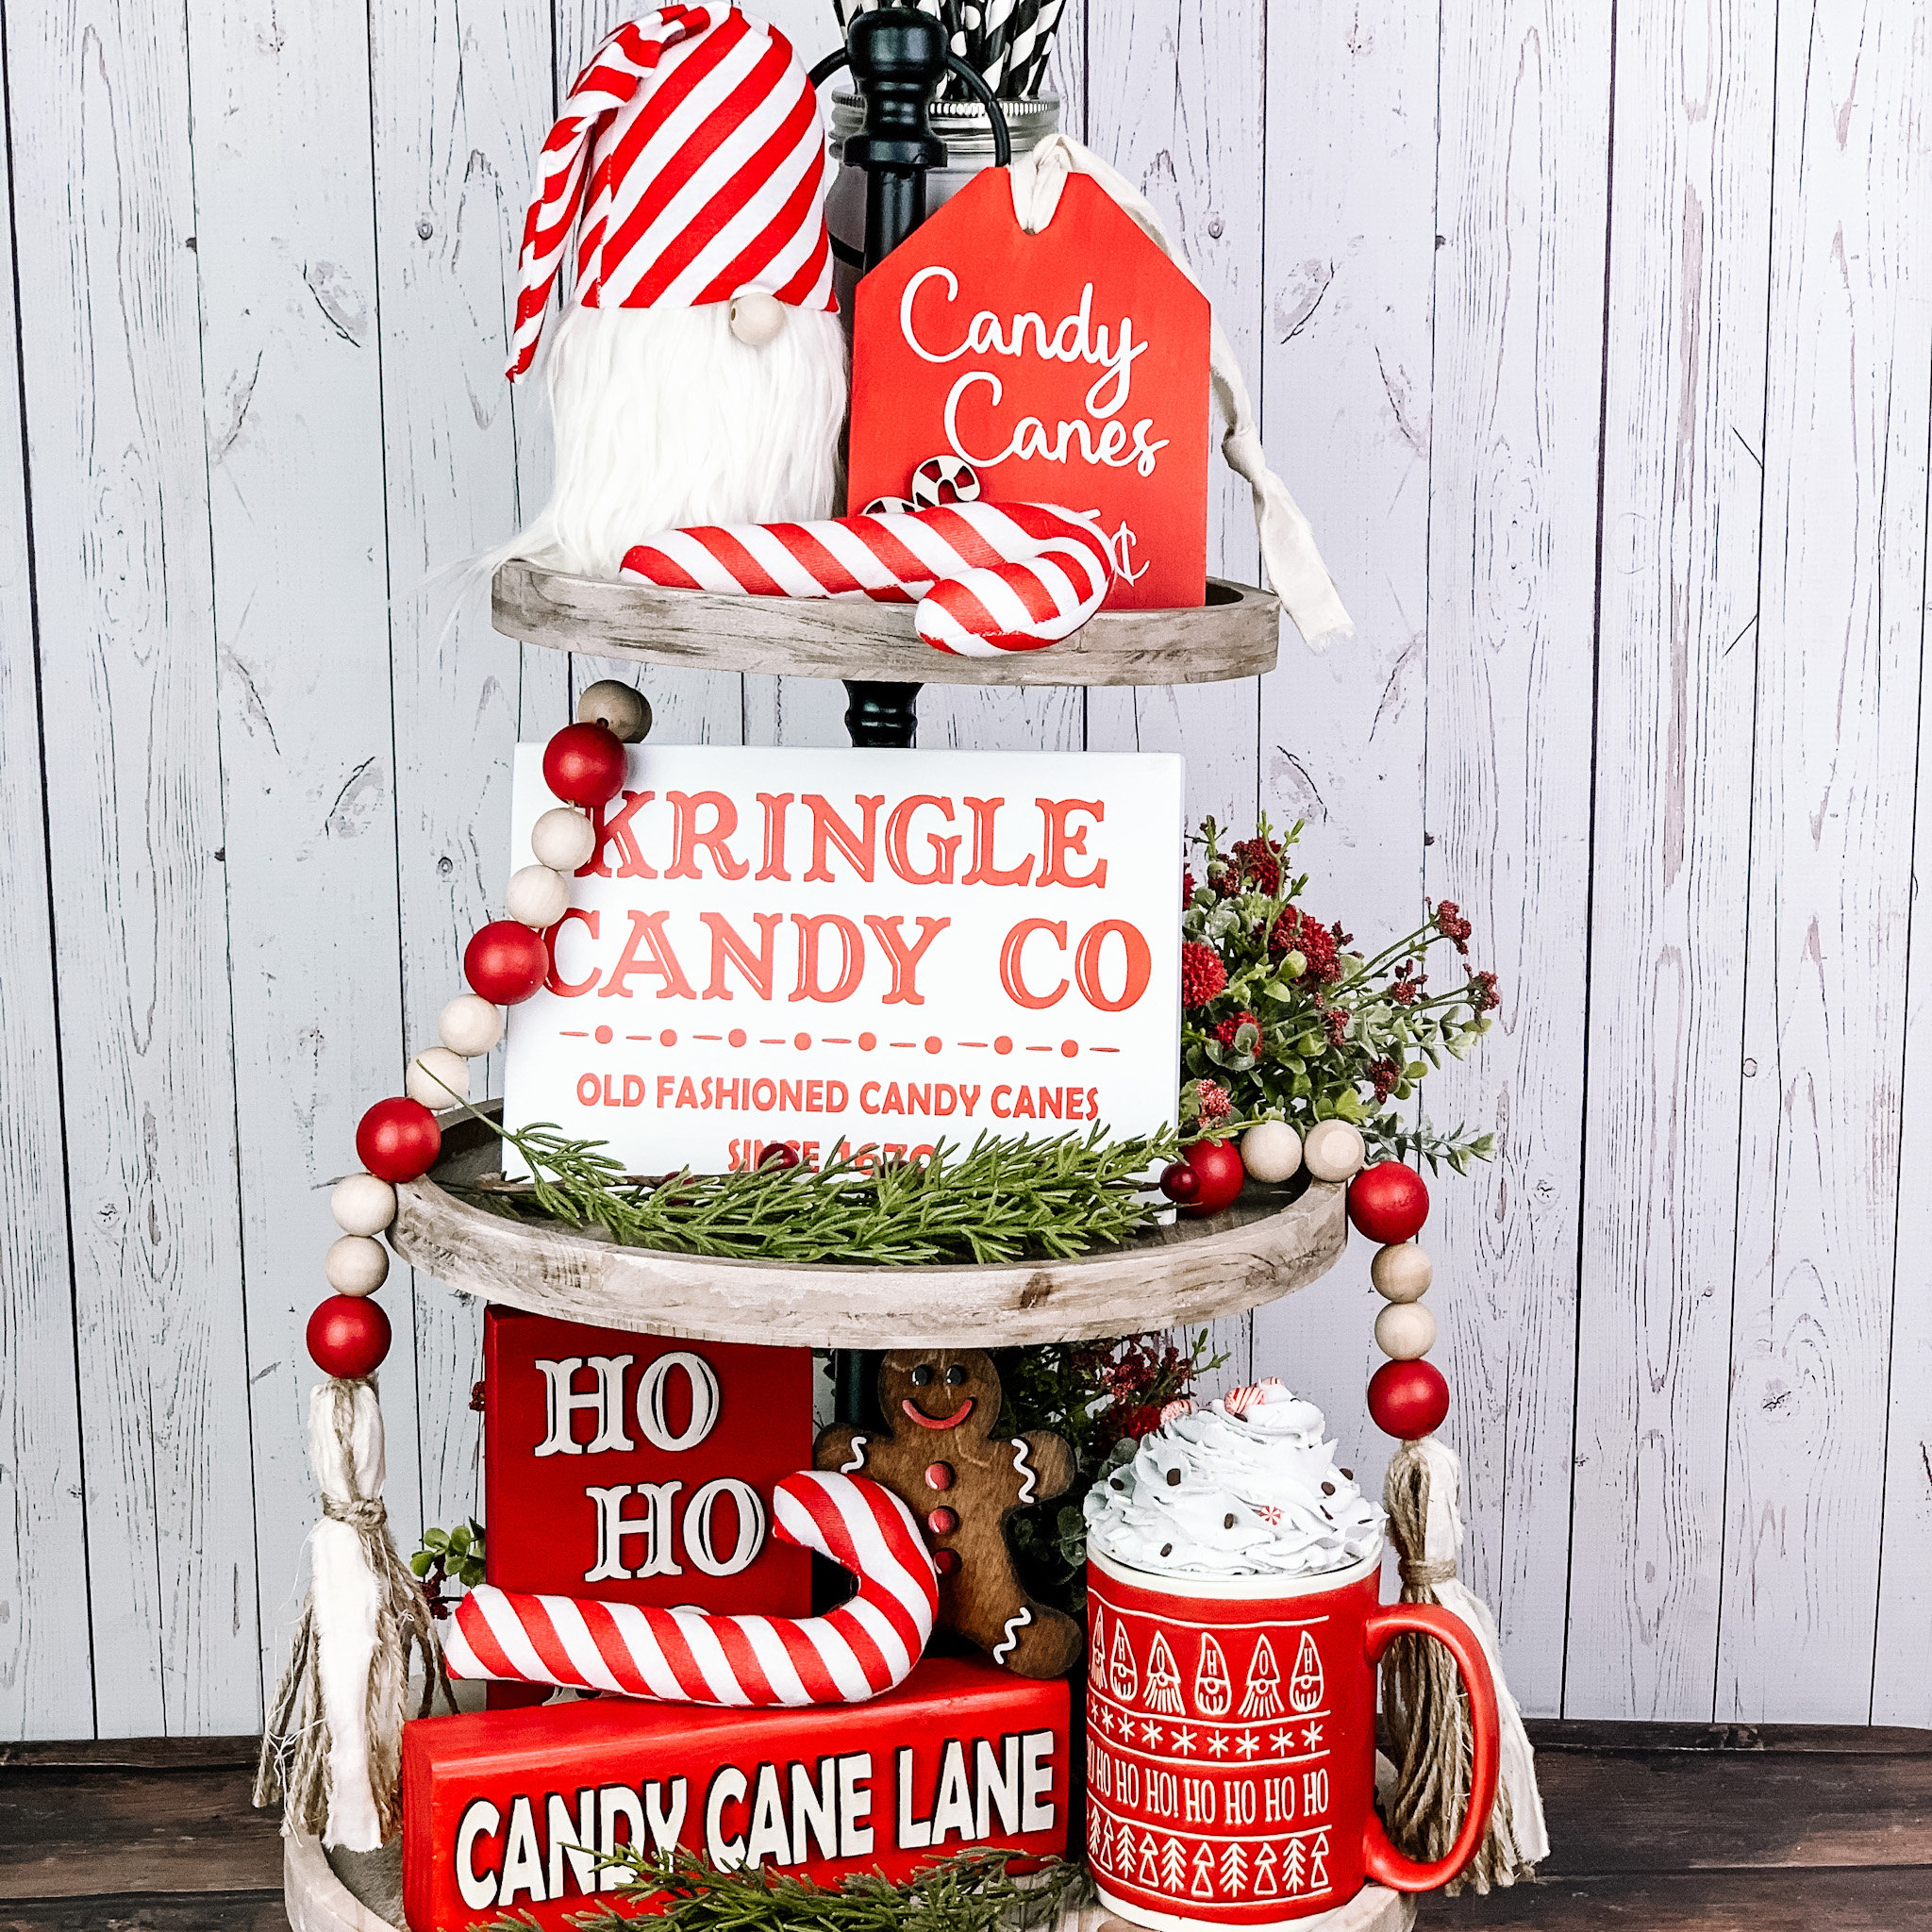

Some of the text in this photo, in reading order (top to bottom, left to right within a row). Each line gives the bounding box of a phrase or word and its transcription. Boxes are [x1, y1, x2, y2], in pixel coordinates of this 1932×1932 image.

[899, 265, 1149, 420] Candy
[943, 371, 1170, 477] Canes
[574, 790, 1109, 889] KRINGLE
[543, 908, 1153, 1012] CANDY CO
[576, 1073, 1100, 1122] OLD FASHIONED CANDY CANES
[534, 1352, 722, 1457] HO
[584, 1478, 766, 1583] HO
[456, 1730, 1055, 1910] CANDY CANE LANE
[1096, 1746, 1111, 1798] HO
[1114, 1758, 1140, 1808] HO
[1145, 1767, 1178, 1819] HO!
[1183, 1777, 1216, 1824] HO
[1224, 1779, 1257, 1824] HO
[1264, 1775, 1295, 1823] HO
[1303, 1767, 1329, 1817] HO
